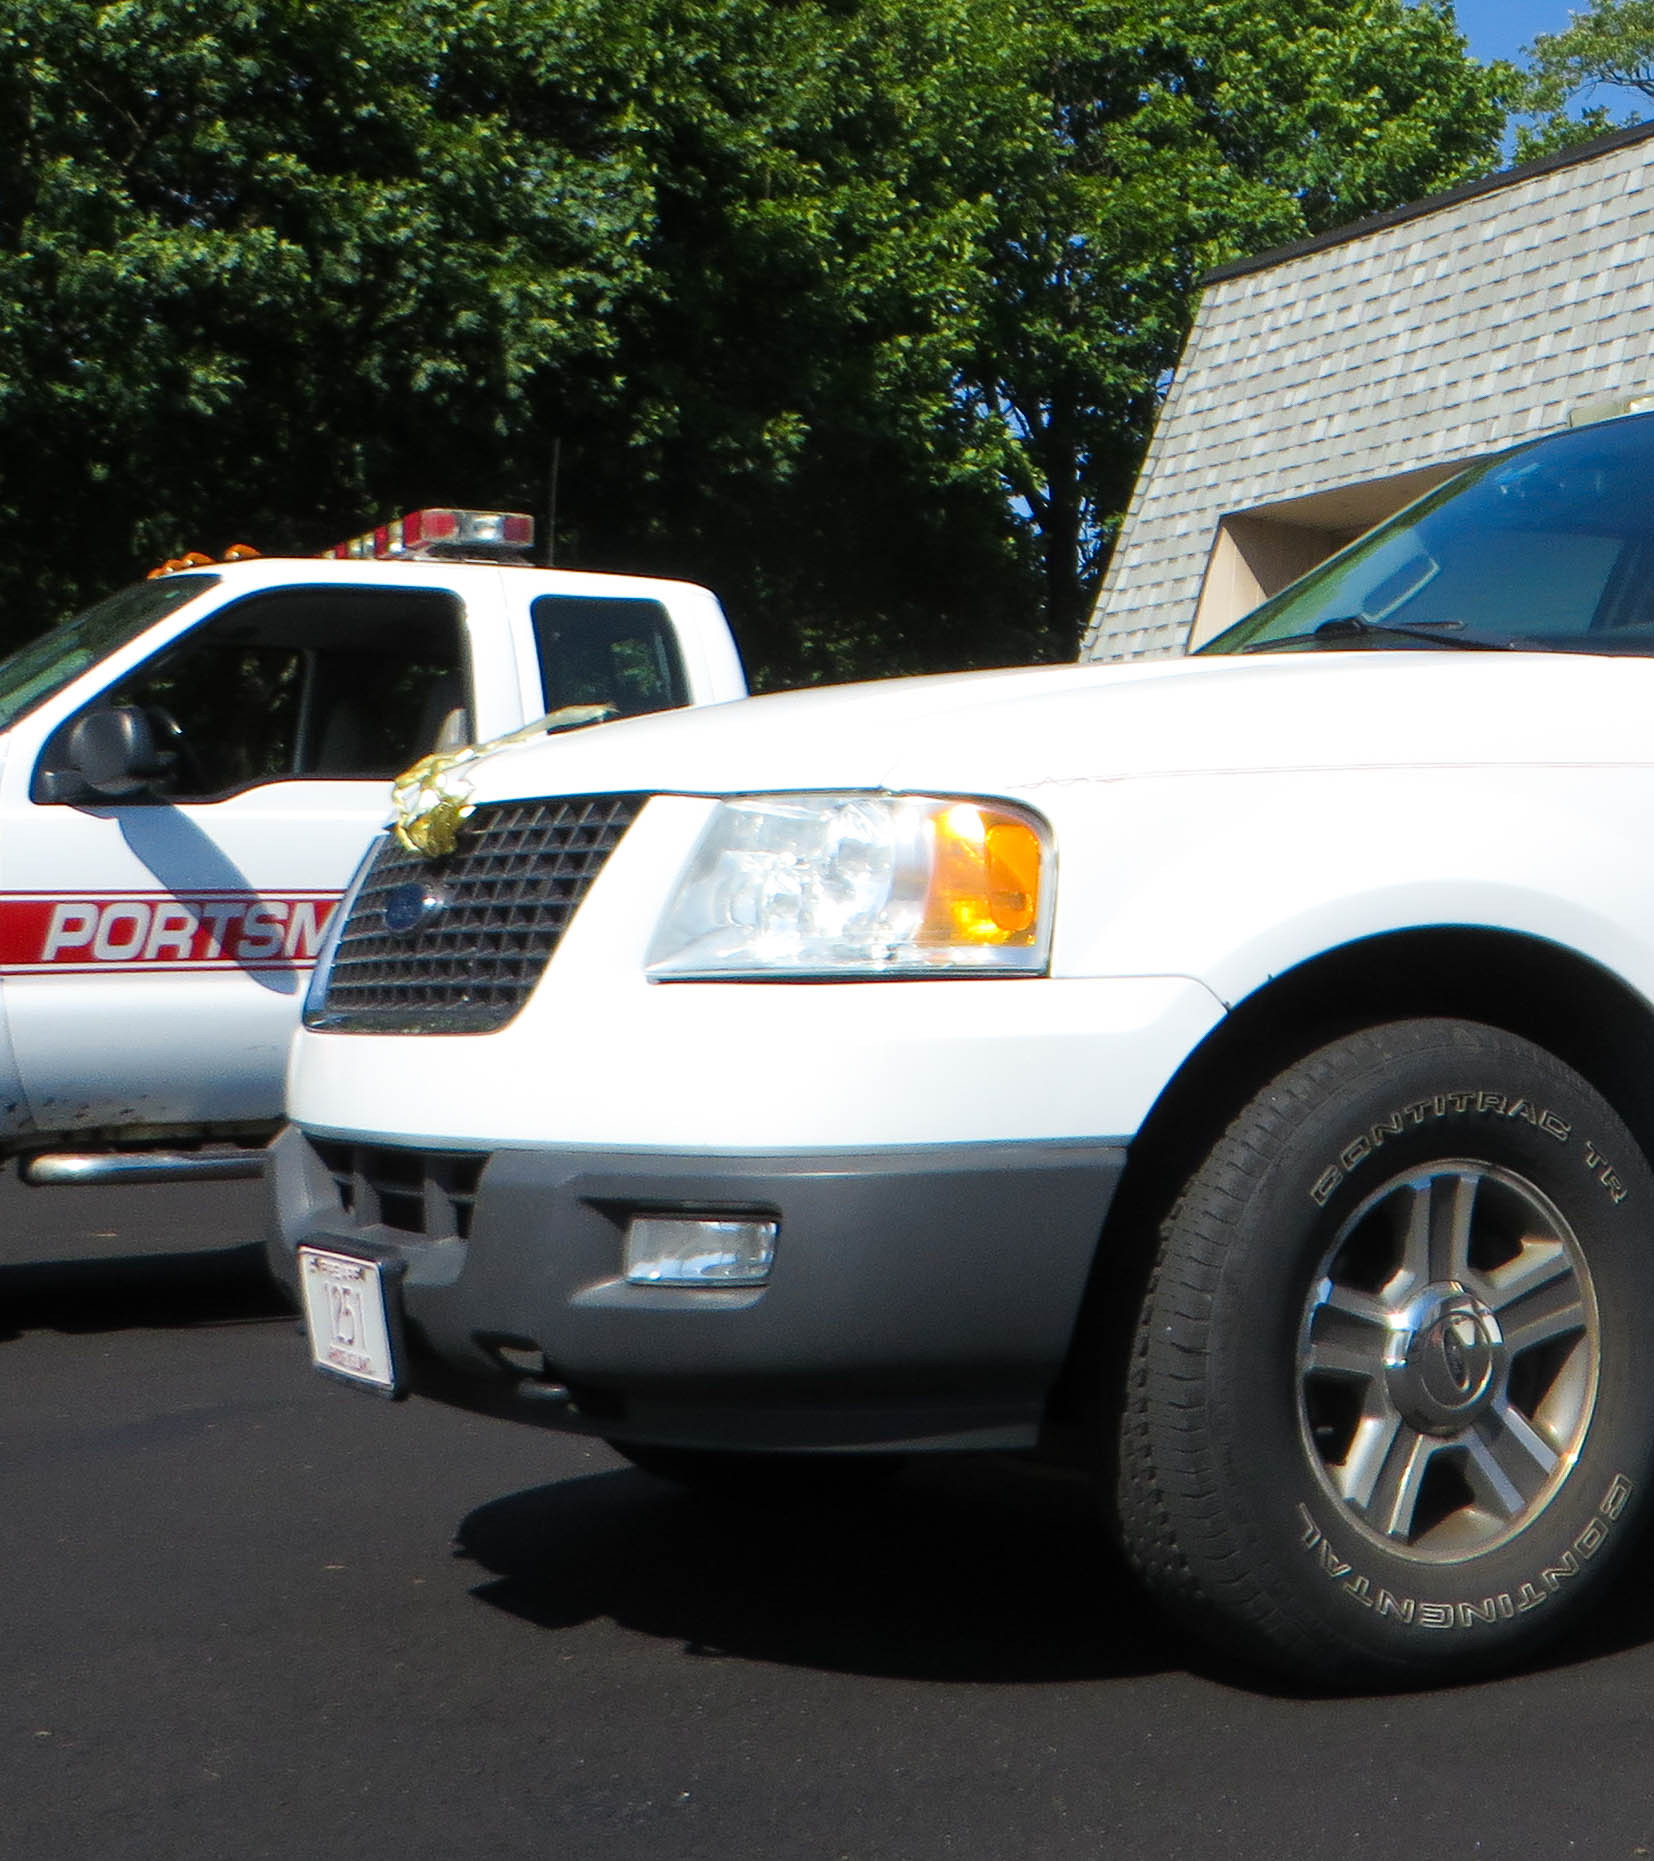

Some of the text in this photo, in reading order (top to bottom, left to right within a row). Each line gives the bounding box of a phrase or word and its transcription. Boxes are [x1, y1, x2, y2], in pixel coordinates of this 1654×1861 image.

[1310, 1090, 1629, 1207] CONTITRAC TR
[1299, 1472, 1633, 1629] CONTINENTAL
